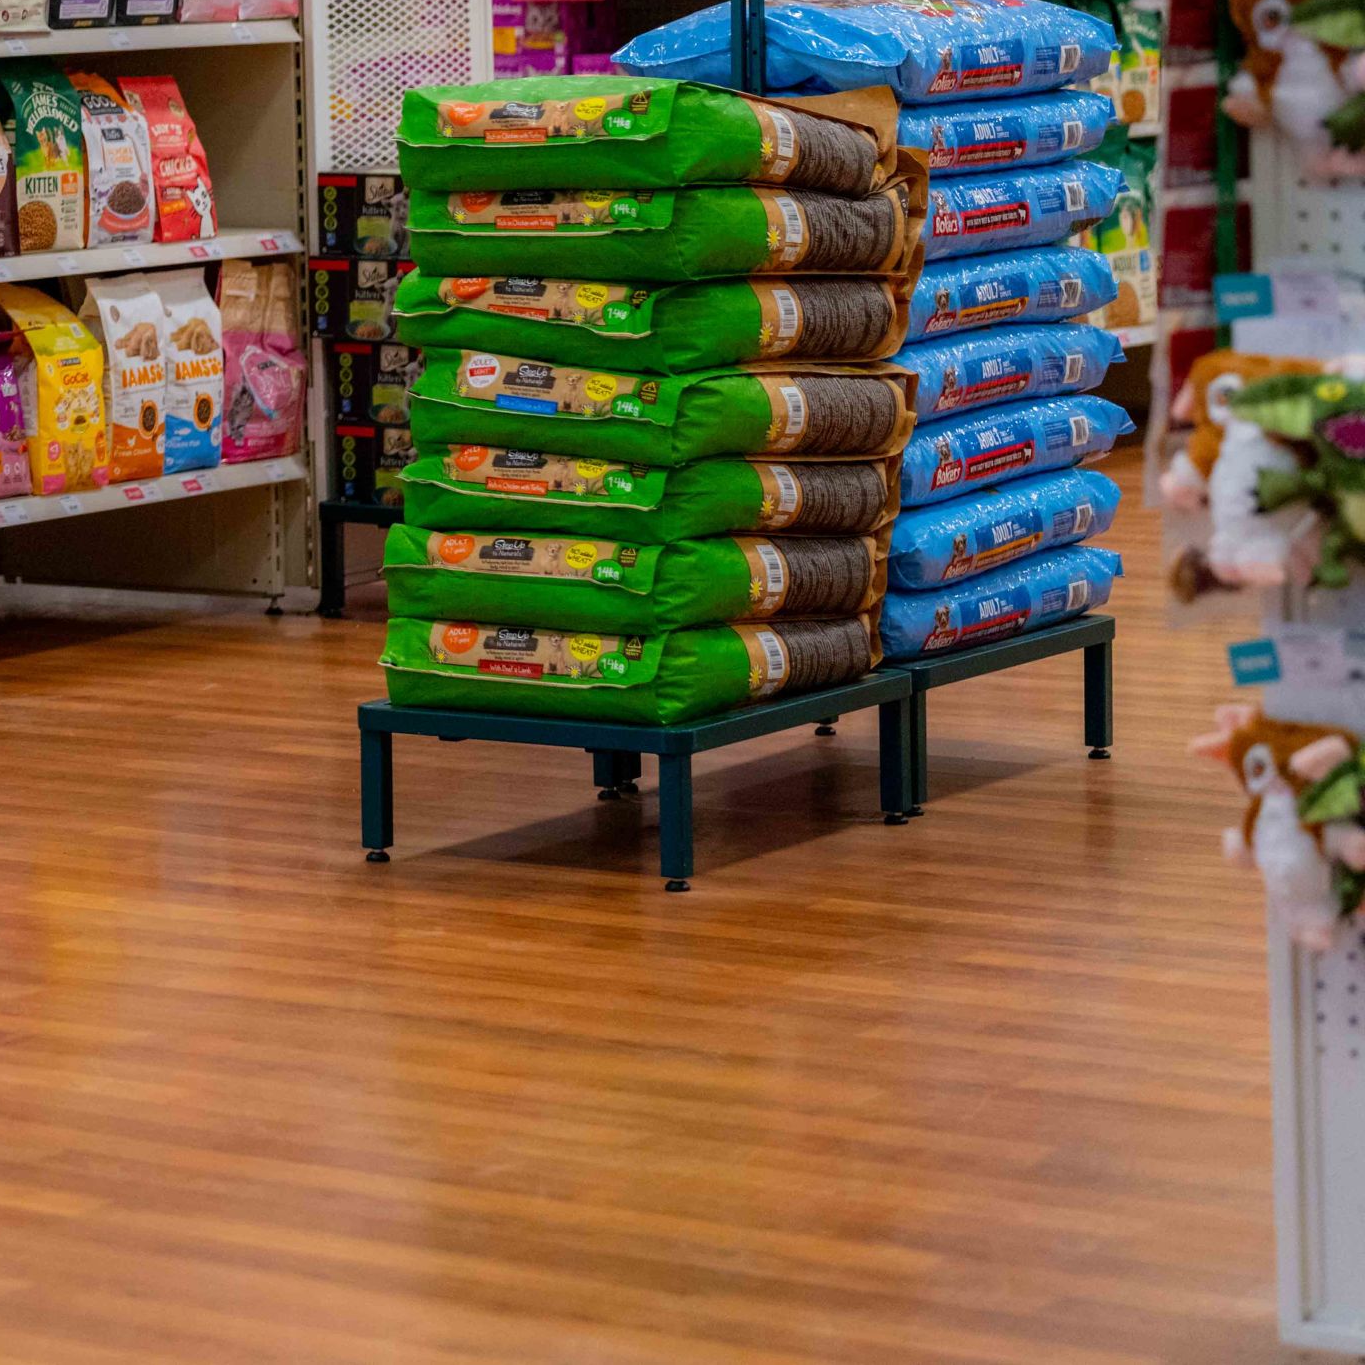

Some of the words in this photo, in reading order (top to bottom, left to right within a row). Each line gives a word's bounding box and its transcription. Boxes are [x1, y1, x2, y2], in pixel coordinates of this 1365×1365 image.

[979, 48, 999, 65] ADULT
[32, 94, 58, 109] JAMES
[606, 115, 632, 130] 14kg
[974, 122, 997, 139] ADULT
[25, 177, 59, 194] KITTEN
[975, 282, 999, 302] ADULT
[175, 360, 212, 381] IAMS
[470, 358, 493, 367] ADULT
[982, 360, 1002, 379] ADULT
[121, 367, 157, 389] IAMS
[615, 399, 640, 416] 14kg
[606, 475, 633, 492] 14kg
[936, 466, 962, 485] Bakers
[992, 522, 1013, 545] ADULT
[445, 538, 468, 548] ADULT
[596, 564, 621, 581] 14kg
[979, 597, 1001, 620] ADULT
[448, 627, 471, 637] ADULT
[925, 635, 955, 650] Bakers
[599, 658, 625, 673] 14kg
